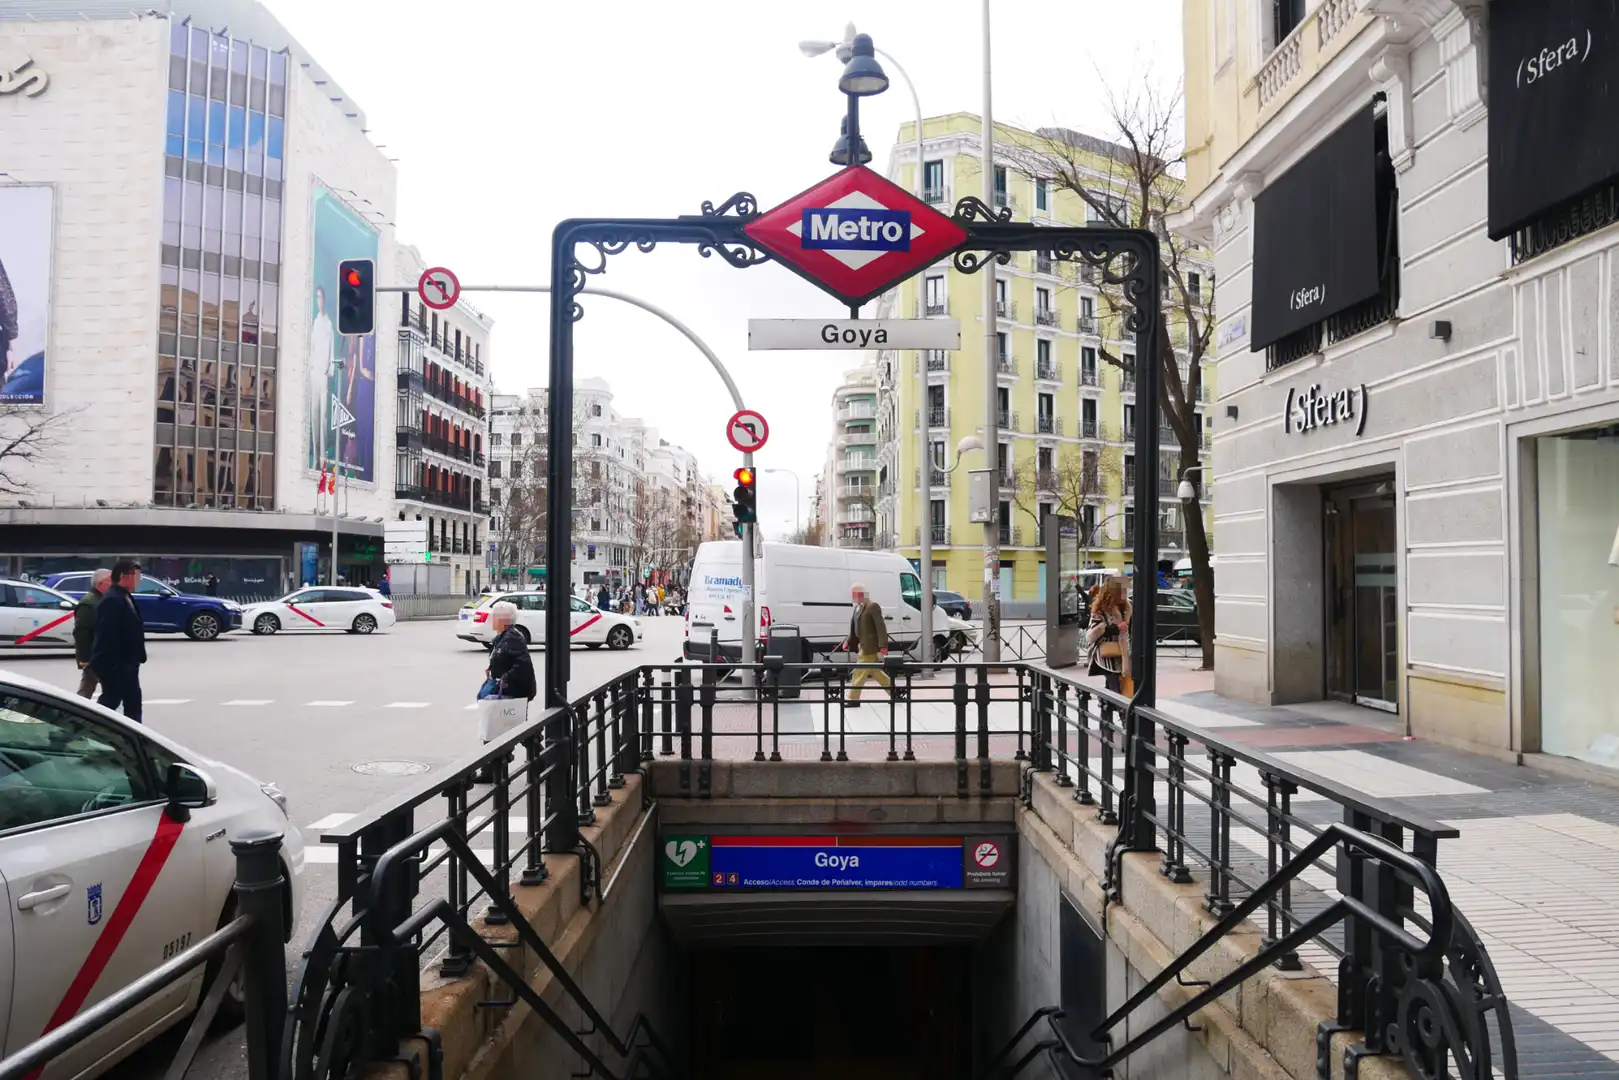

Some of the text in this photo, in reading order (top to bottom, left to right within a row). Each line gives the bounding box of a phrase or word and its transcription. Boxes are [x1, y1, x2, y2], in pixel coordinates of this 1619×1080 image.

[811, 214, 903, 242] Metro
[821, 324, 888, 347] Goya
[815, 852, 859, 871] Goya
[715, 874, 736, 883] 2 4
[831, 879, 864, 887] Peñalver,
